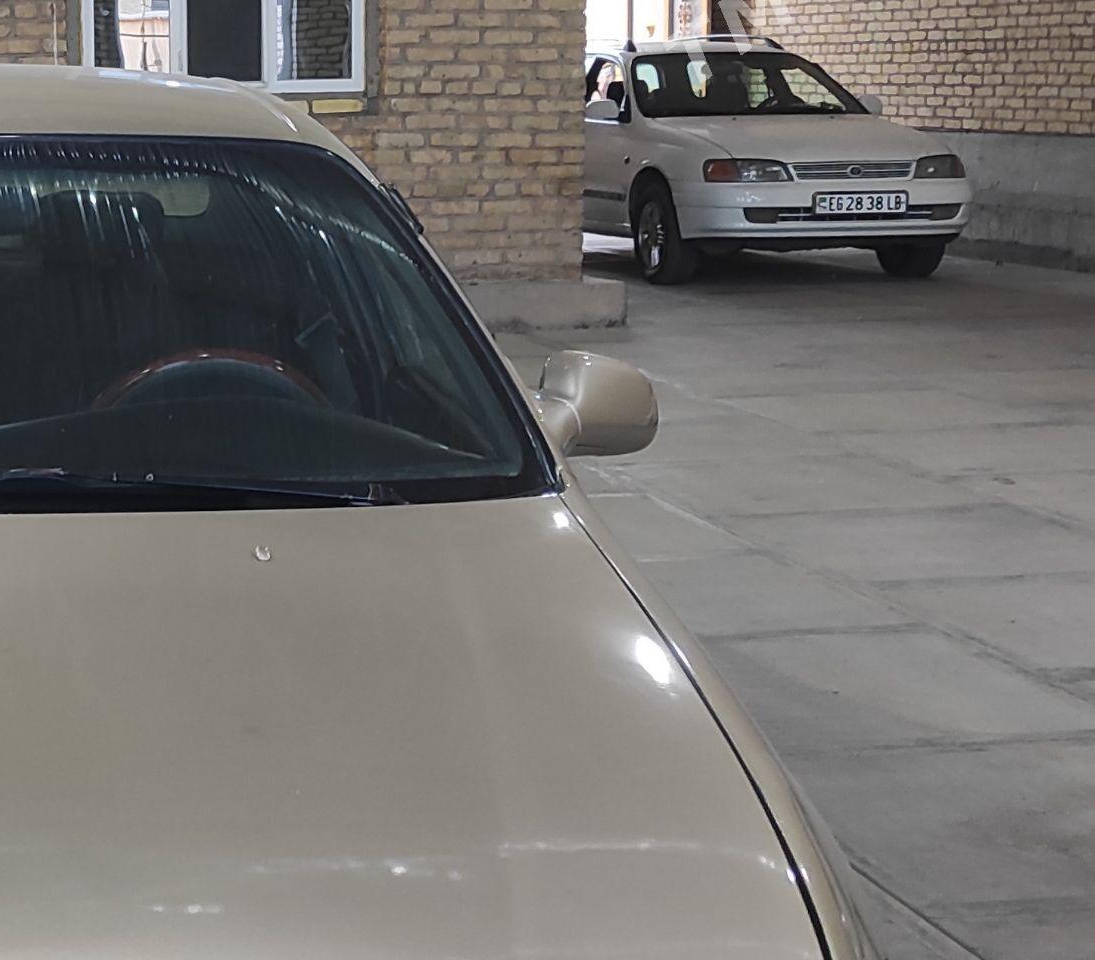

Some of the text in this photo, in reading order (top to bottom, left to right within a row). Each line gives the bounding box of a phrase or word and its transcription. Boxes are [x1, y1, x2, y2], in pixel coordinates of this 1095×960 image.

[846, 196, 863, 211] 28
[866, 195, 883, 211] 38
[887, 195, 902, 210] LB
